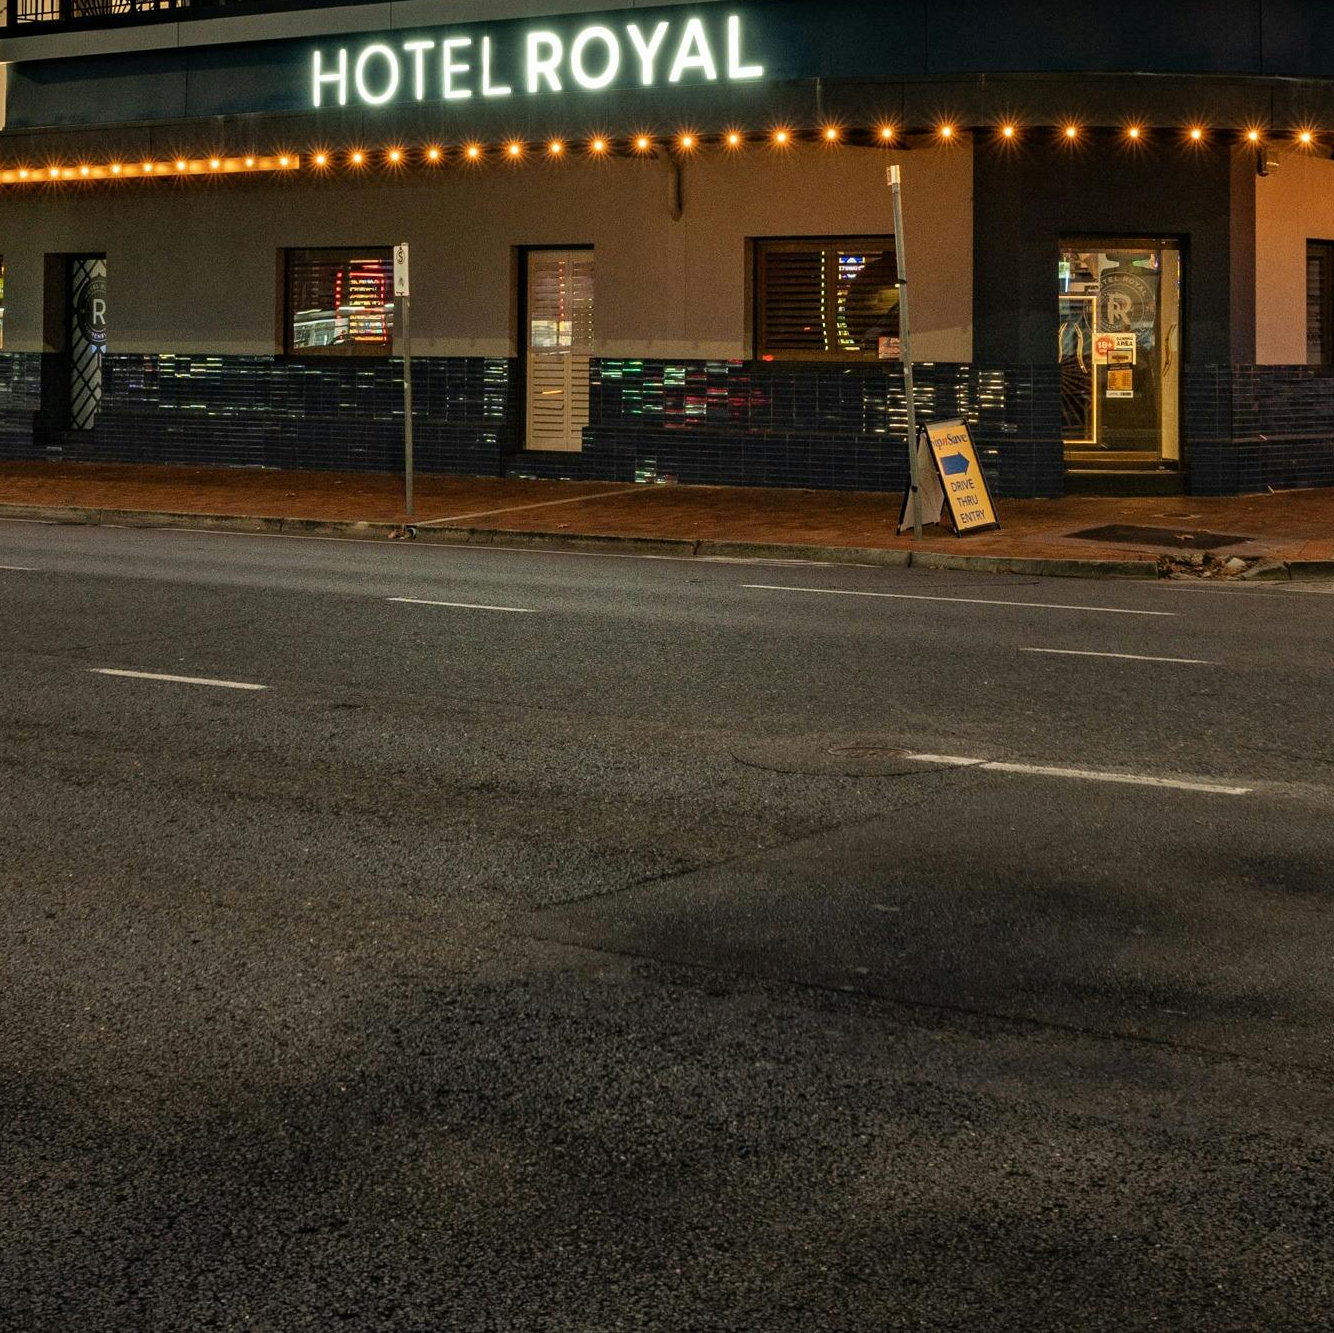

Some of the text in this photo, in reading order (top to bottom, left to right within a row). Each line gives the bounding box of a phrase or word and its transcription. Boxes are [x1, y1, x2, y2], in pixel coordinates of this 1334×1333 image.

[312, 15, 764, 107] HOTEL ROYAL
[93, 299, 106, 325] R
[950, 478, 975, 492] DRIVE
[957, 495, 978, 507] THRU
[960, 509, 985, 524] ENTRY
